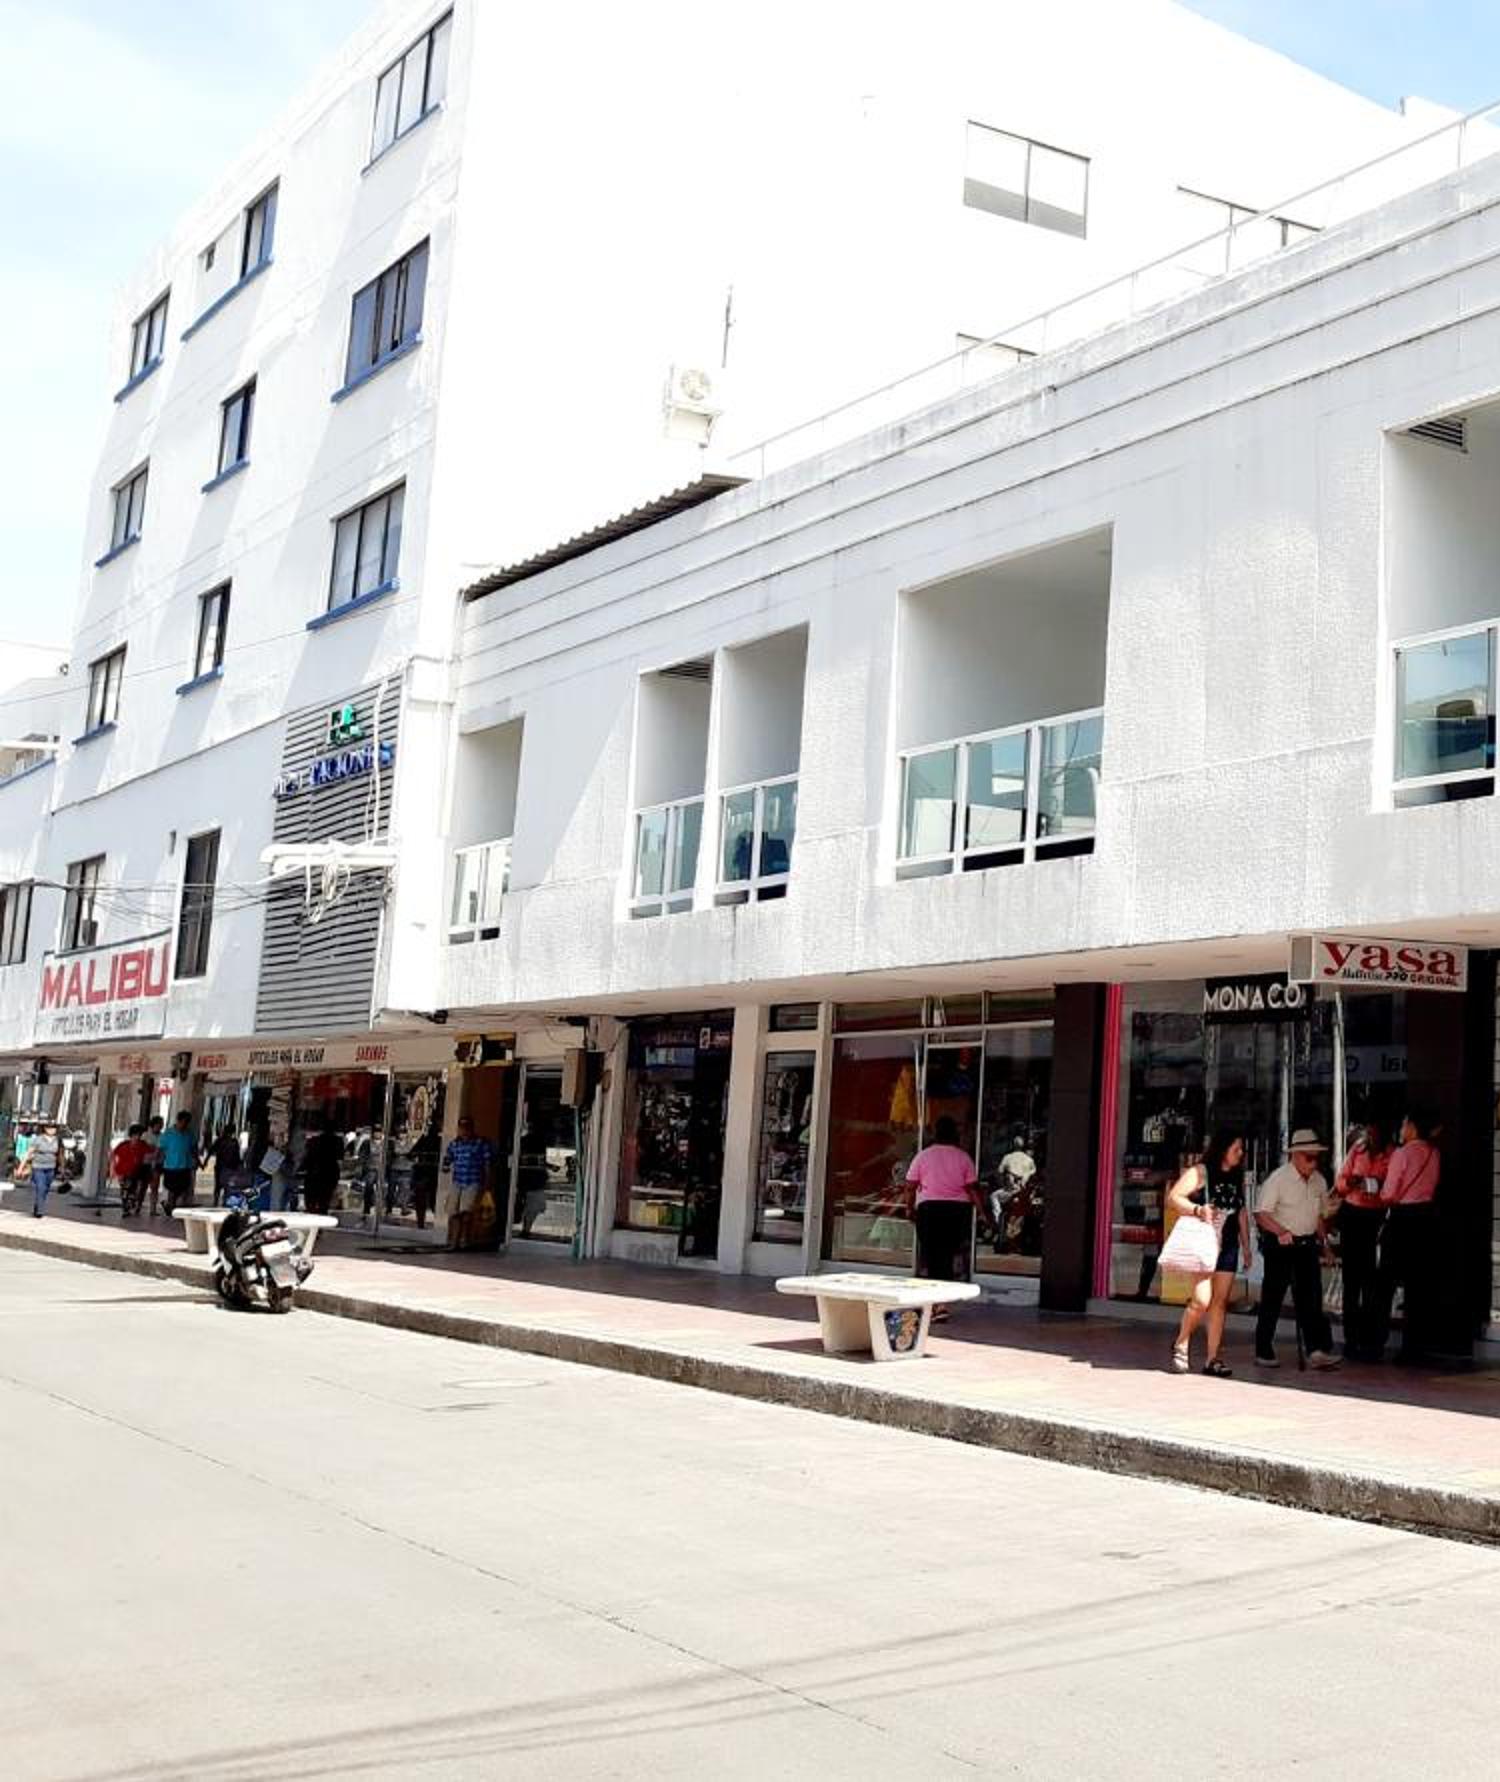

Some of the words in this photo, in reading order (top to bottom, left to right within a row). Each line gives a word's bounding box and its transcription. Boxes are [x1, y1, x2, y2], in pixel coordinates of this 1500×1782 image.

[40, 943, 170, 1009] MALIBU
[1320, 941, 1461, 976] yasa
[1203, 982, 1301, 1013] MONACO
